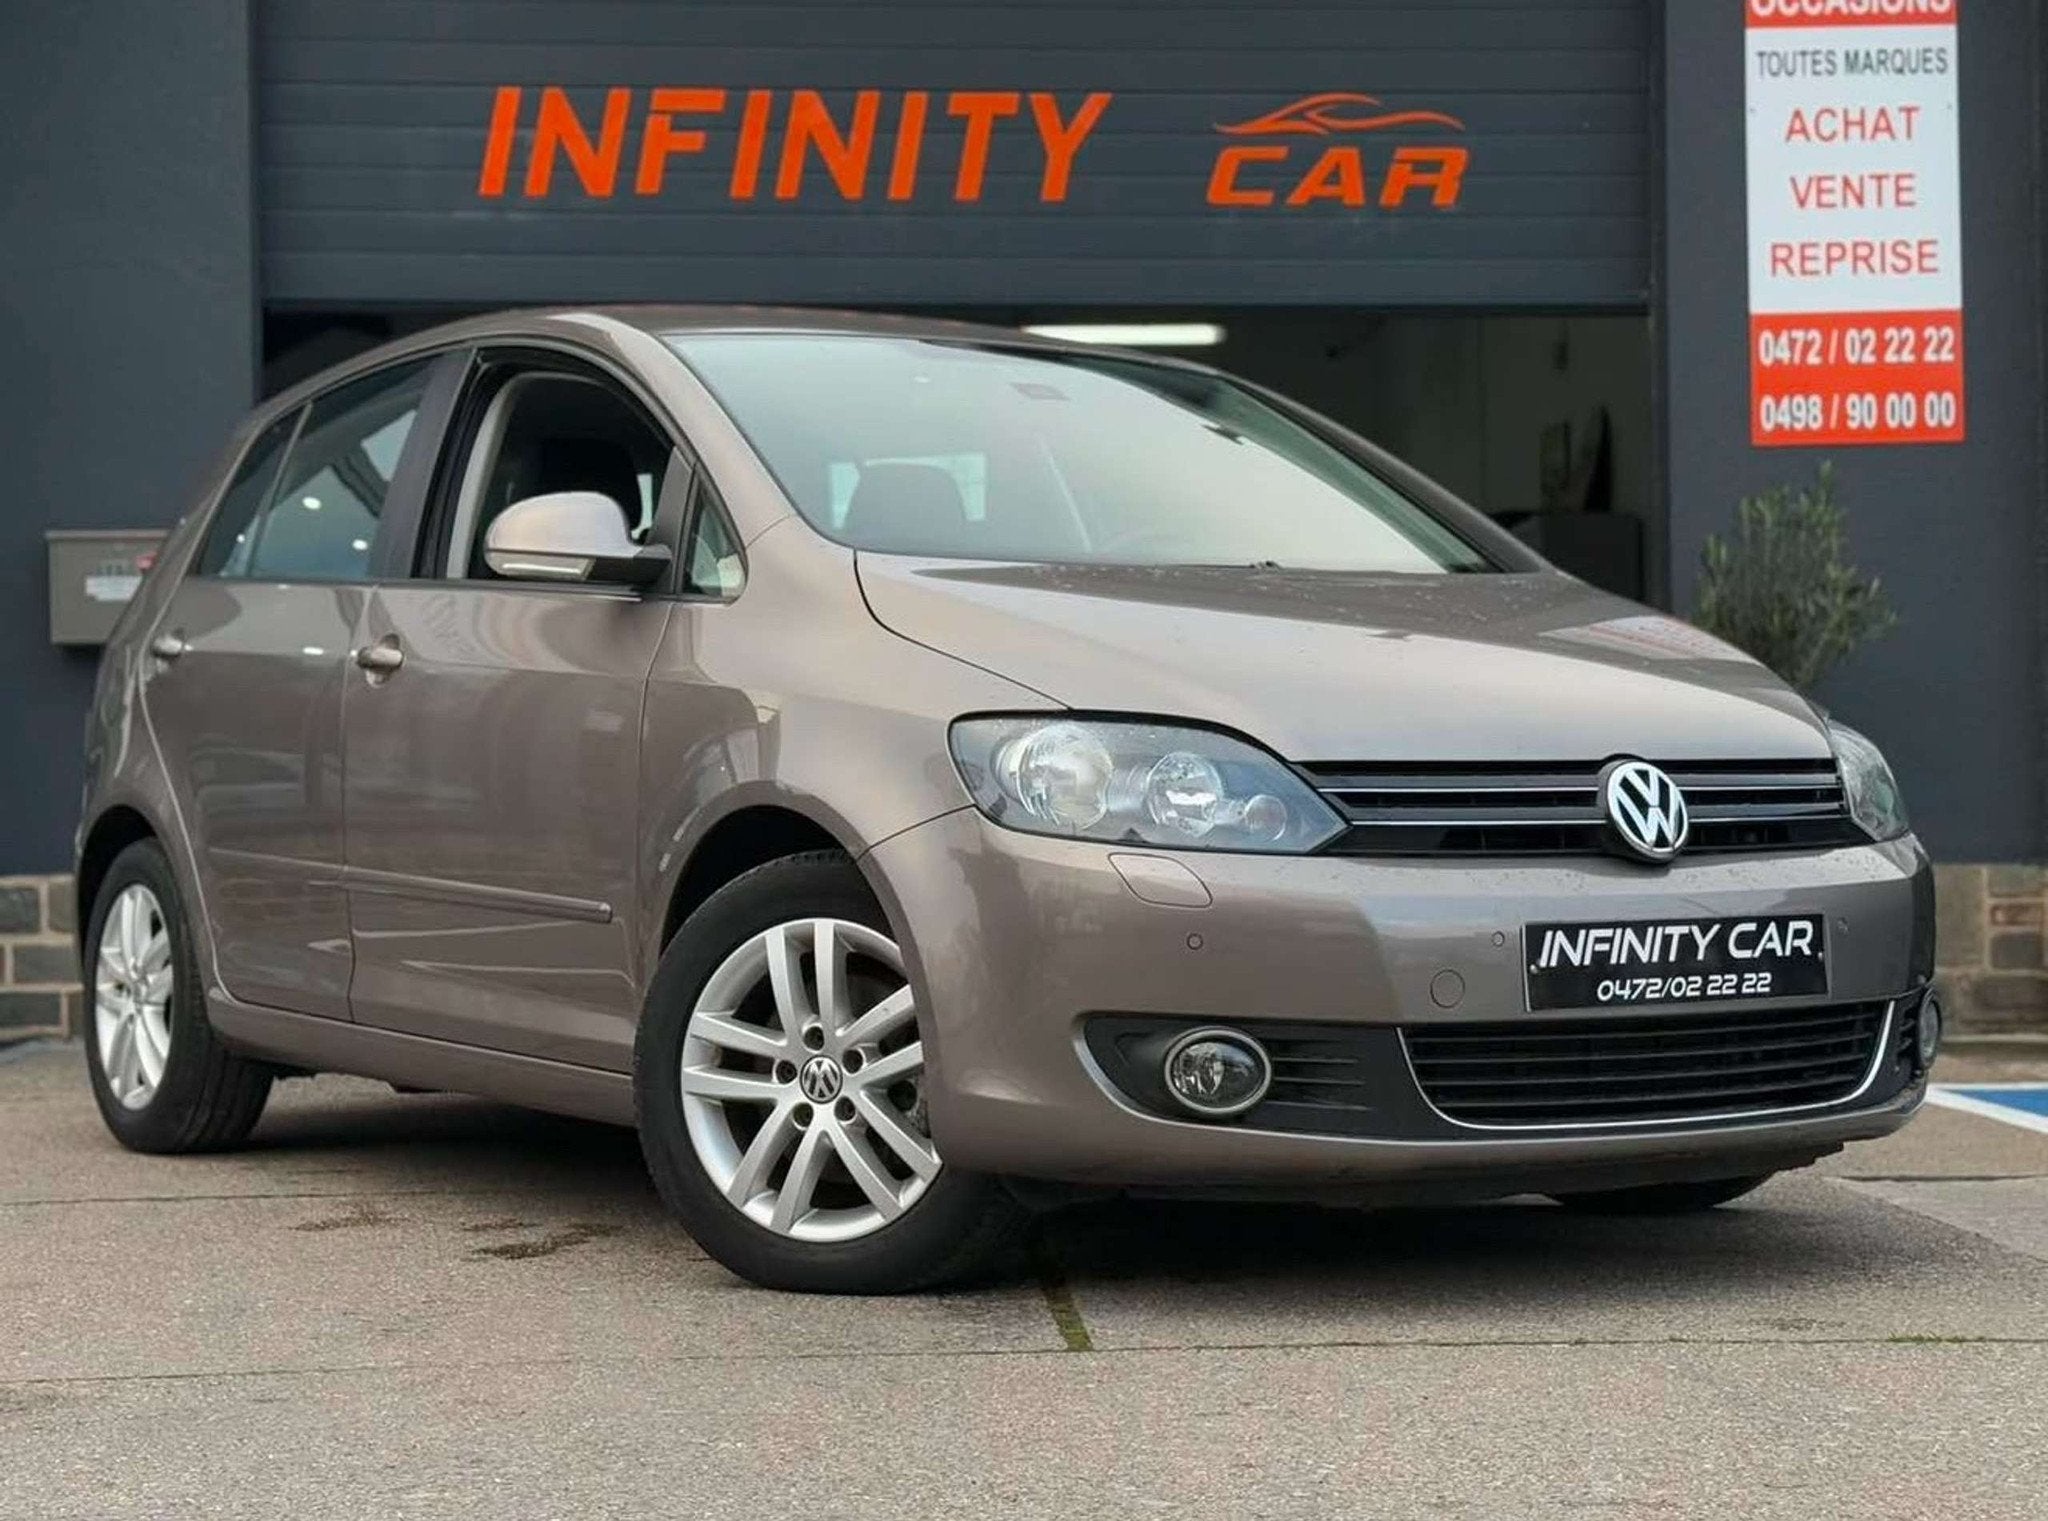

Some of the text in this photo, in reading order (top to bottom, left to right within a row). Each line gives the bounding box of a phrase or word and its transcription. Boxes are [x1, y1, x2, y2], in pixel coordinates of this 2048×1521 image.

[1756, 48, 1949, 77] TOUTES MARQUES
[1785, 106, 1920, 143] ACHAT
[478, 85, 1470, 209] INFINITY CAR
[1790, 173, 1916, 209] VENTE
[1770, 240, 1939, 277] REPRISE
[1759, 329, 1823, 367] 0472
[1845, 327, 1877, 364] 02
[1884, 326, 1916, 363] 22
[1923, 325, 1955, 362] 22
[1760, 394, 1823, 432] 0498
[1846, 393, 1878, 429] 90
[1885, 392, 1917, 428] 00
[1924, 391, 1956, 427] 00
[1539, 920, 1813, 968] INFINITY CAR
[1597, 972, 1772, 1001] 0472/02 22 22
